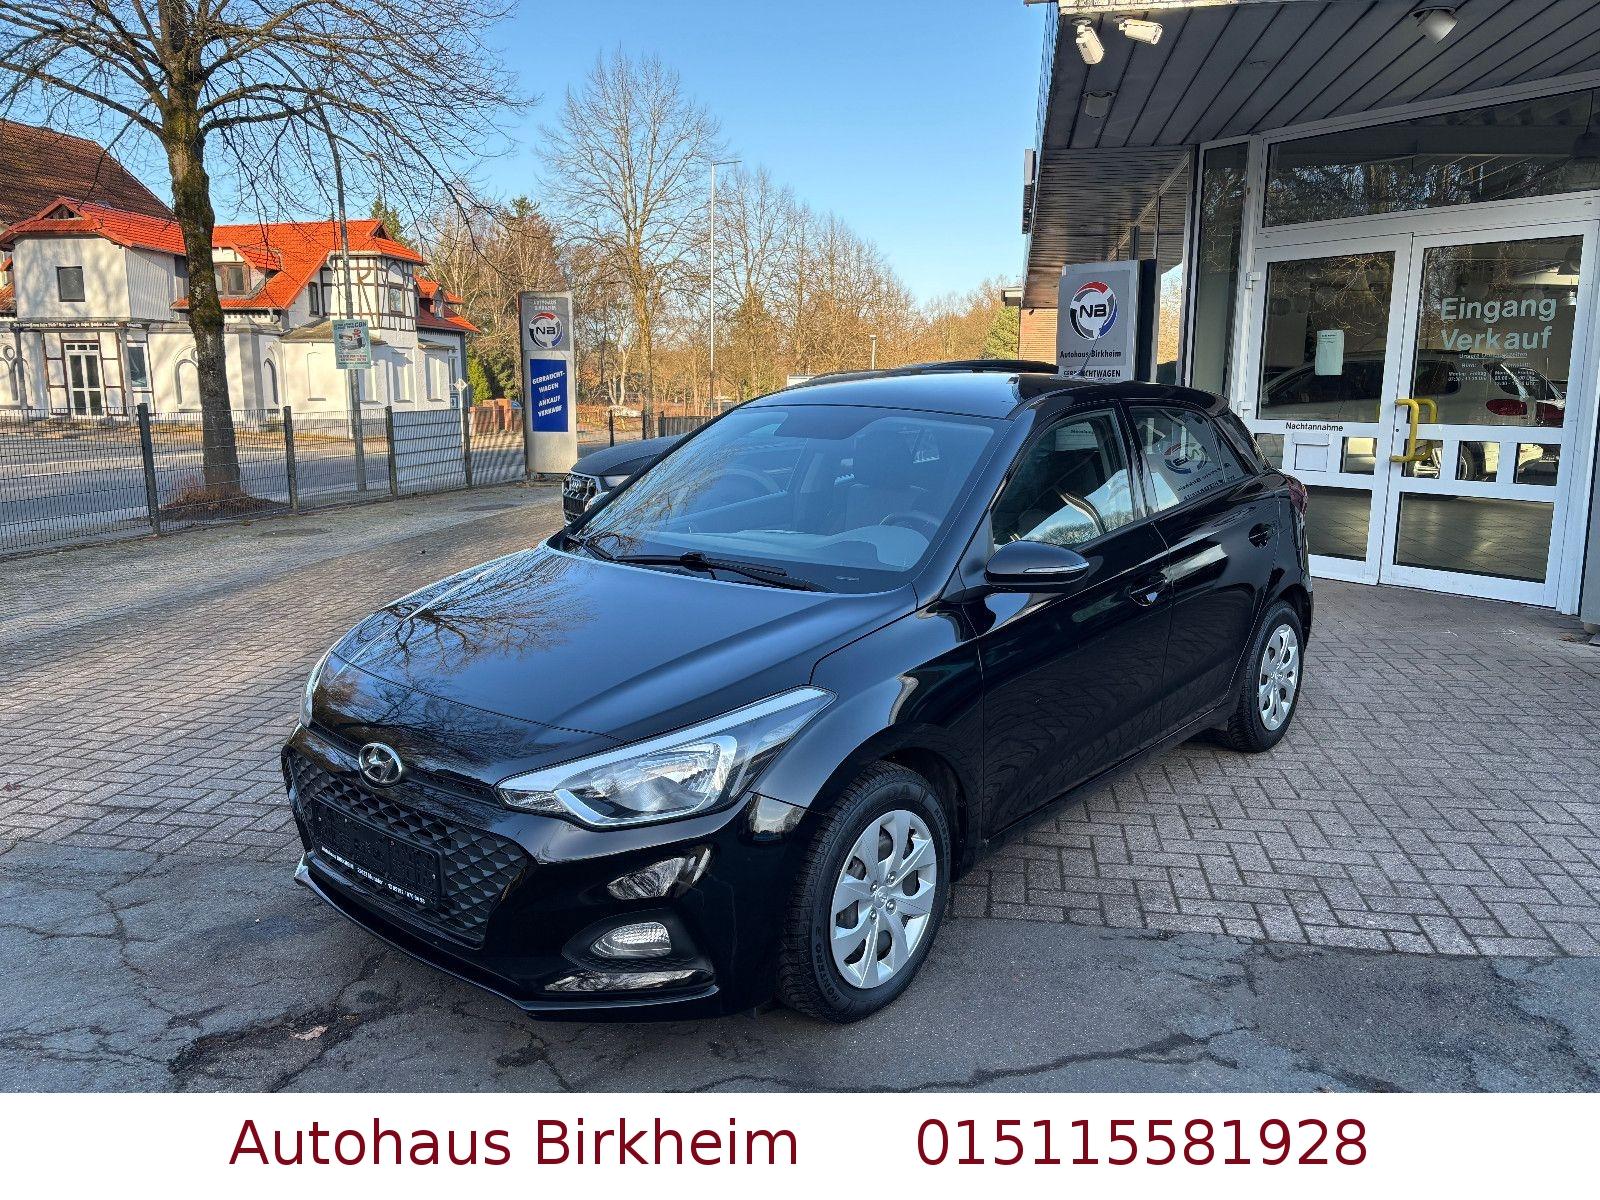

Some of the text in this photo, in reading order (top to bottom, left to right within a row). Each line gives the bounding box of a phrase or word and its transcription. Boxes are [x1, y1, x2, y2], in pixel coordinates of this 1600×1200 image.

[1080, 304, 1107, 318] NB
[1441, 297, 1557, 324] Eingang
[536, 327, 556, 335] NB
[1441, 325, 1553, 351] Verkauf
[1060, 349, 1122, 359] Autohaus Birkheim
[532, 371, 565, 384] GEBRAUCHT-
[1063, 369, 1121, 378] GEBCHTWAGEN
[538, 383, 559, 393] WAGEN
[538, 395, 560, 407] ANKAUF
[538, 405, 562, 417] VERKAUF
[1285, 422, 1344, 432] Nachtannahme
